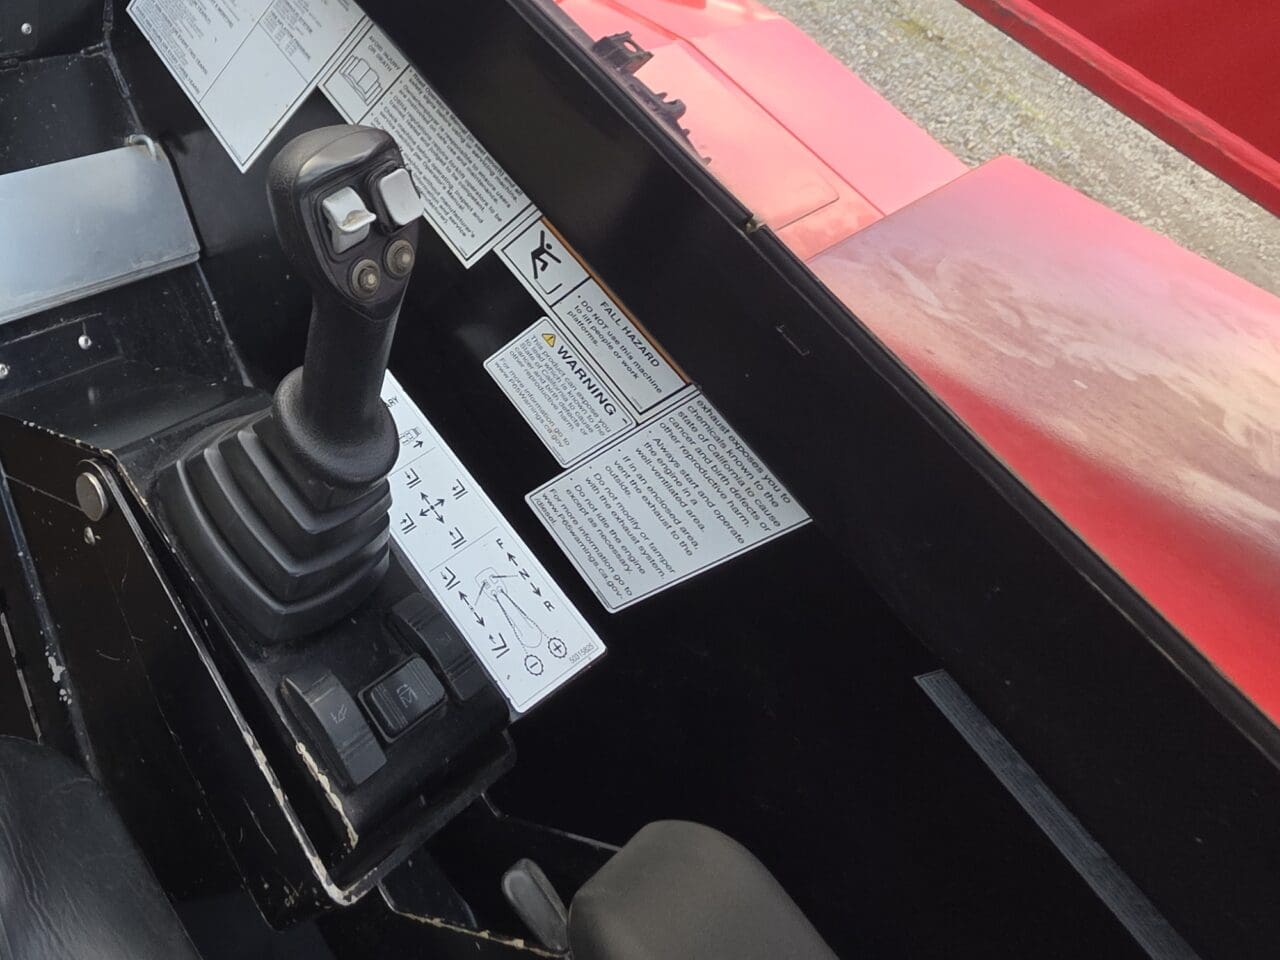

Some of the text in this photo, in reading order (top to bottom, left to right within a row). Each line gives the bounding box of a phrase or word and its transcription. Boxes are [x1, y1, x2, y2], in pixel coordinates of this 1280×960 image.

[566, 310, 597, 346] platforms.
[574, 304, 639, 379] to lift people or work
[580, 299, 593, 312] DO
[591, 312, 609, 329] NOT
[606, 330, 620, 345] use
[619, 344, 633, 360] this
[632, 360, 662, 393] machine
[599, 301, 621, 326] FALL
[621, 325, 659, 366] HAZARD
[557, 345, 616, 415] WARNING
[635, 447, 688, 507] well-ventilated
[643, 441, 657, 456] the
[656, 457, 682, 486] engine
[681, 486, 691, 498] in
[658, 420, 680, 443] other
[679, 445, 727, 499] reproductive
[666, 413, 771, 531] cancer and birth defects or
[676, 410, 780, 527] state of California to cause
[686, 405, 778, 507] chemicals known to the
[696, 399, 794, 503] exhaust exposes you to
[565, 488, 589, 516] except
[587, 516, 597, 528] as
[573, 483, 645, 574] Do not idle the engine
[585, 477, 600, 494] with
[598, 494, 611, 509] the
[610, 510, 640, 544] exhaust
[592, 472, 675, 573] Do not modify or tamper
[613, 460, 692, 556] vent the exhaust to the
[627, 462, 637, 472] in
[635, 473, 647, 485] an
[646, 486, 682, 525] enclosed
[652, 438, 744, 544] Always start and operate
[495, 537, 505, 550] F
[518, 568, 531, 582] N
[547, 486, 562, 502] For
[560, 503, 578, 525] more
[577, 525, 614, 573] information
[612, 574, 625, 585] go
[623, 586, 632, 596] to
[543, 600, 555, 612] R
